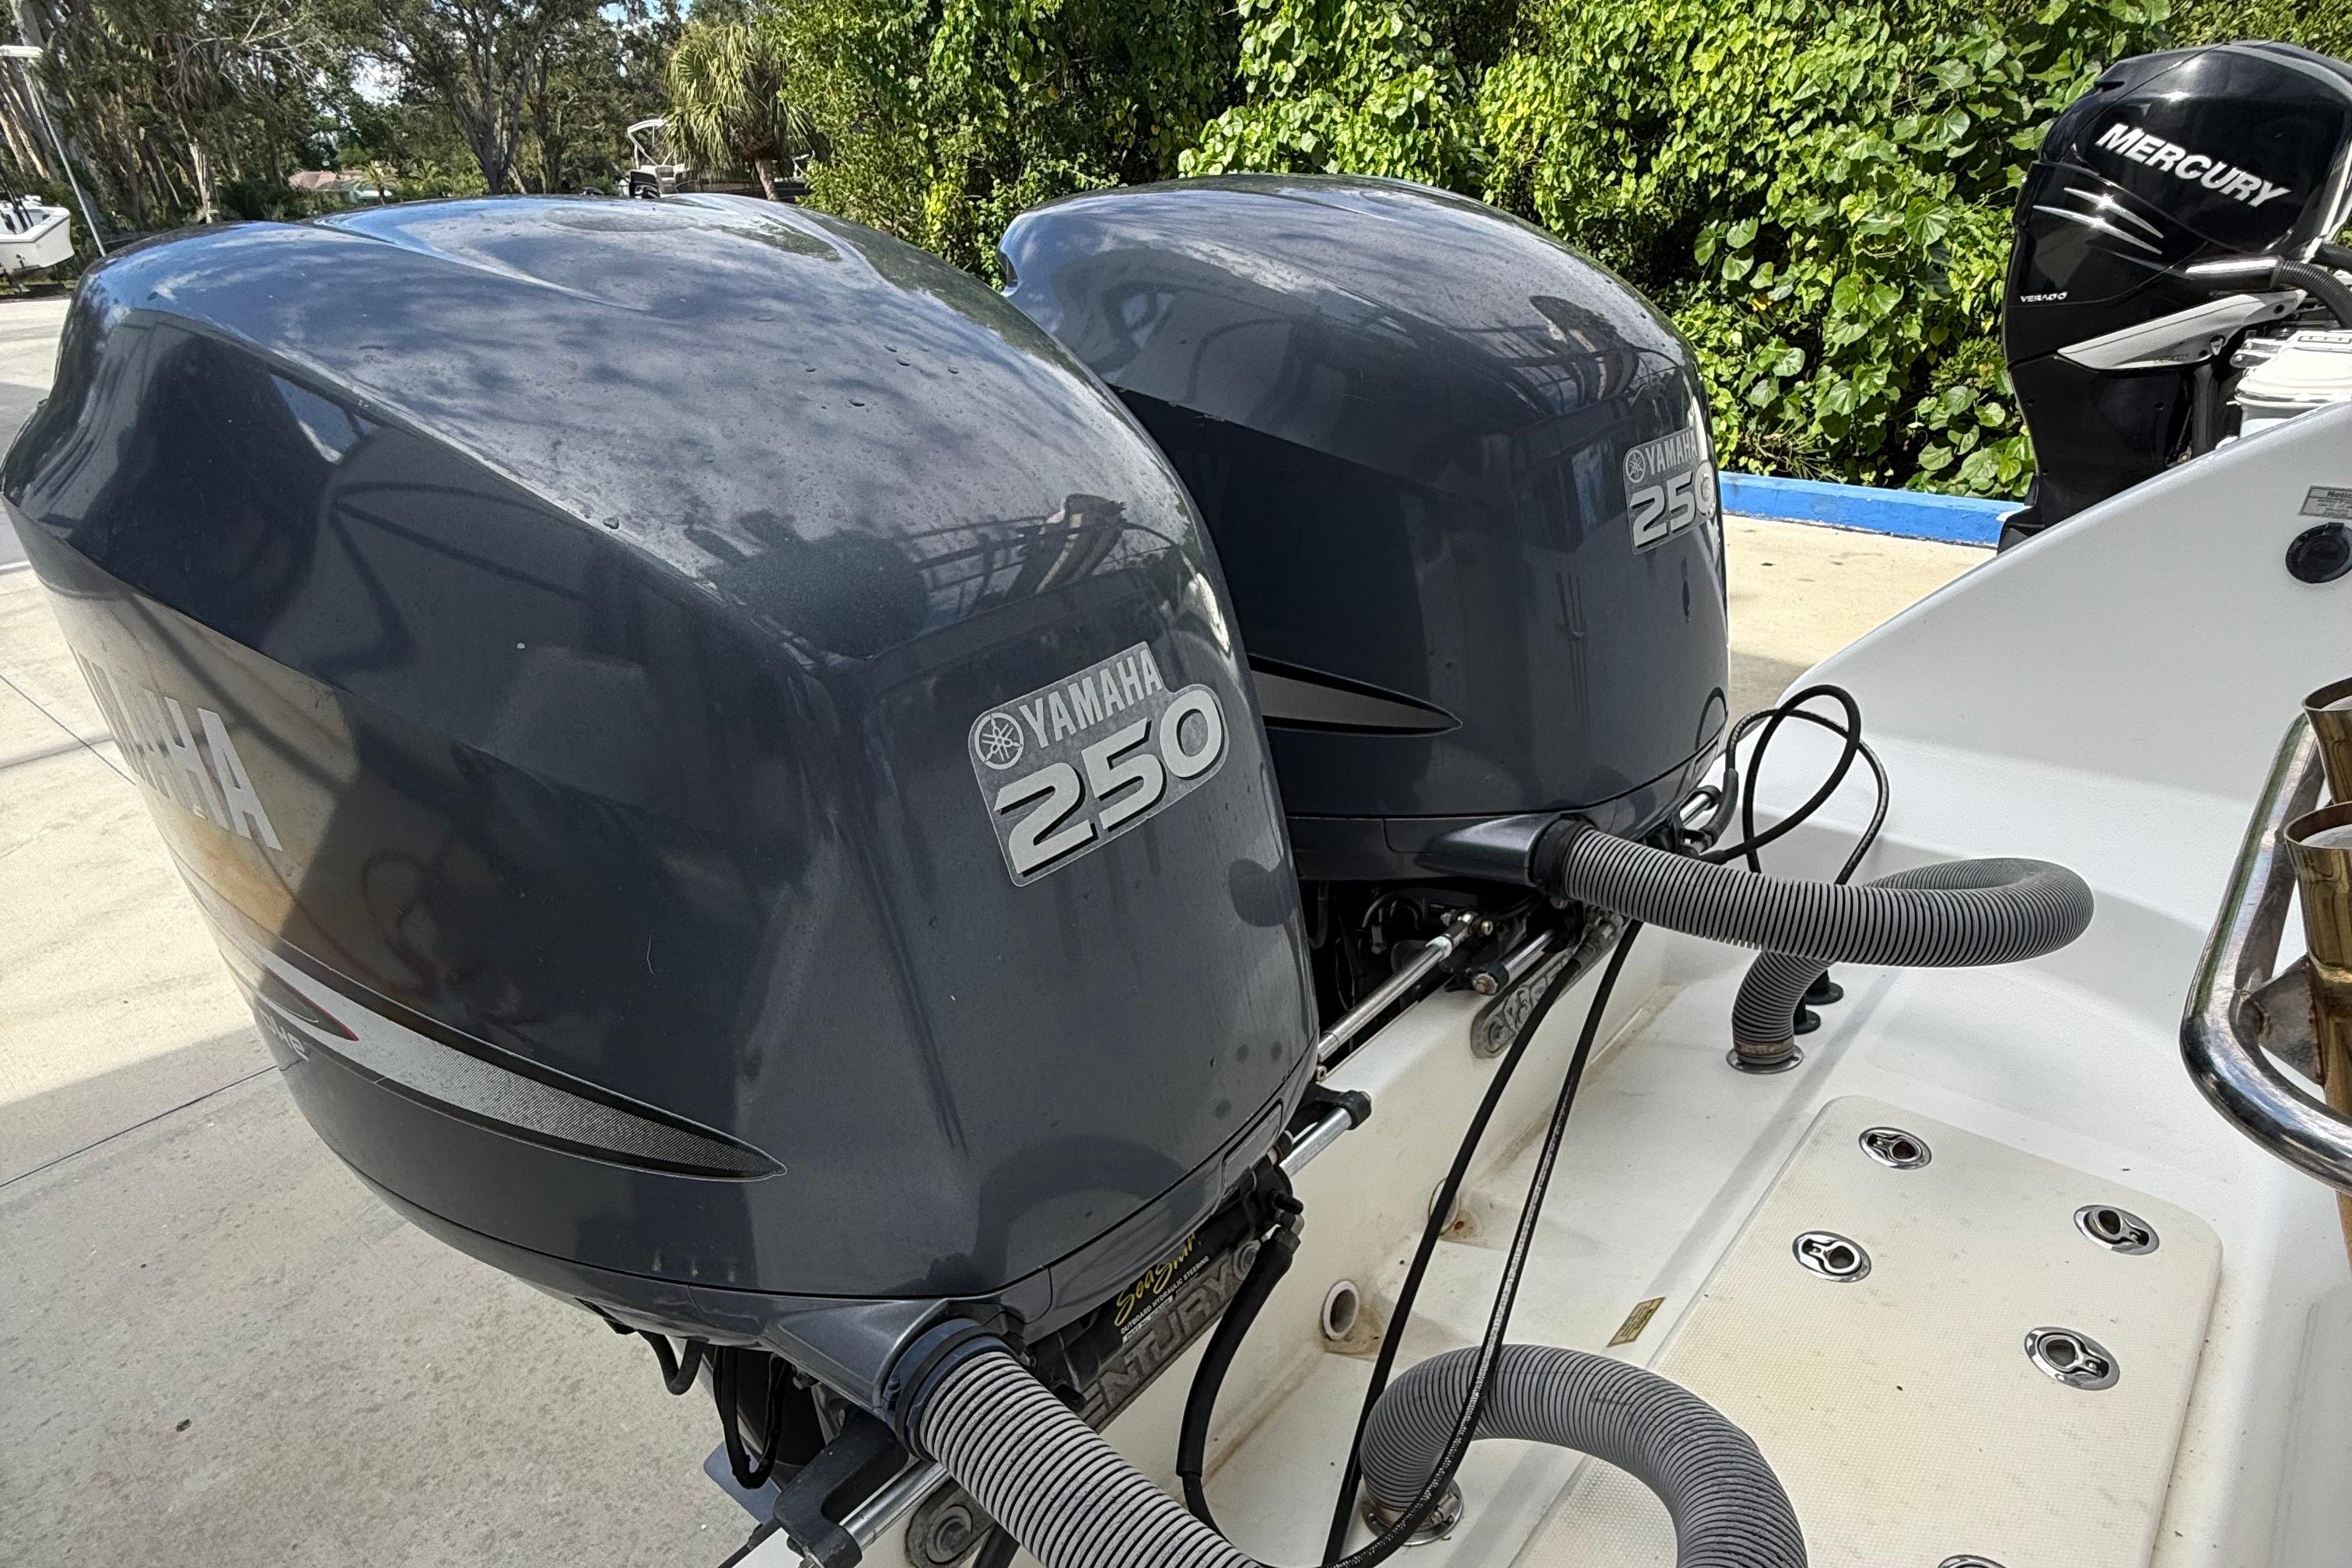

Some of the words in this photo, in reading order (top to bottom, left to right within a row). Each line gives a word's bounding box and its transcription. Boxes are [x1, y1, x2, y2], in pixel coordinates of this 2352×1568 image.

[2095, 121, 2292, 208] MERCURY
[1645, 430, 1699, 475] YAMAHA
[1629, 460, 1716, 549] 250
[1019, 649, 1164, 748] YAMAHA
[994, 689, 1226, 877] 250
[1120, 1304, 1153, 1335] OUTBOARD
[1152, 1277, 1184, 1308] HYDRAULIC
[1183, 1255, 1210, 1281] STEERING
